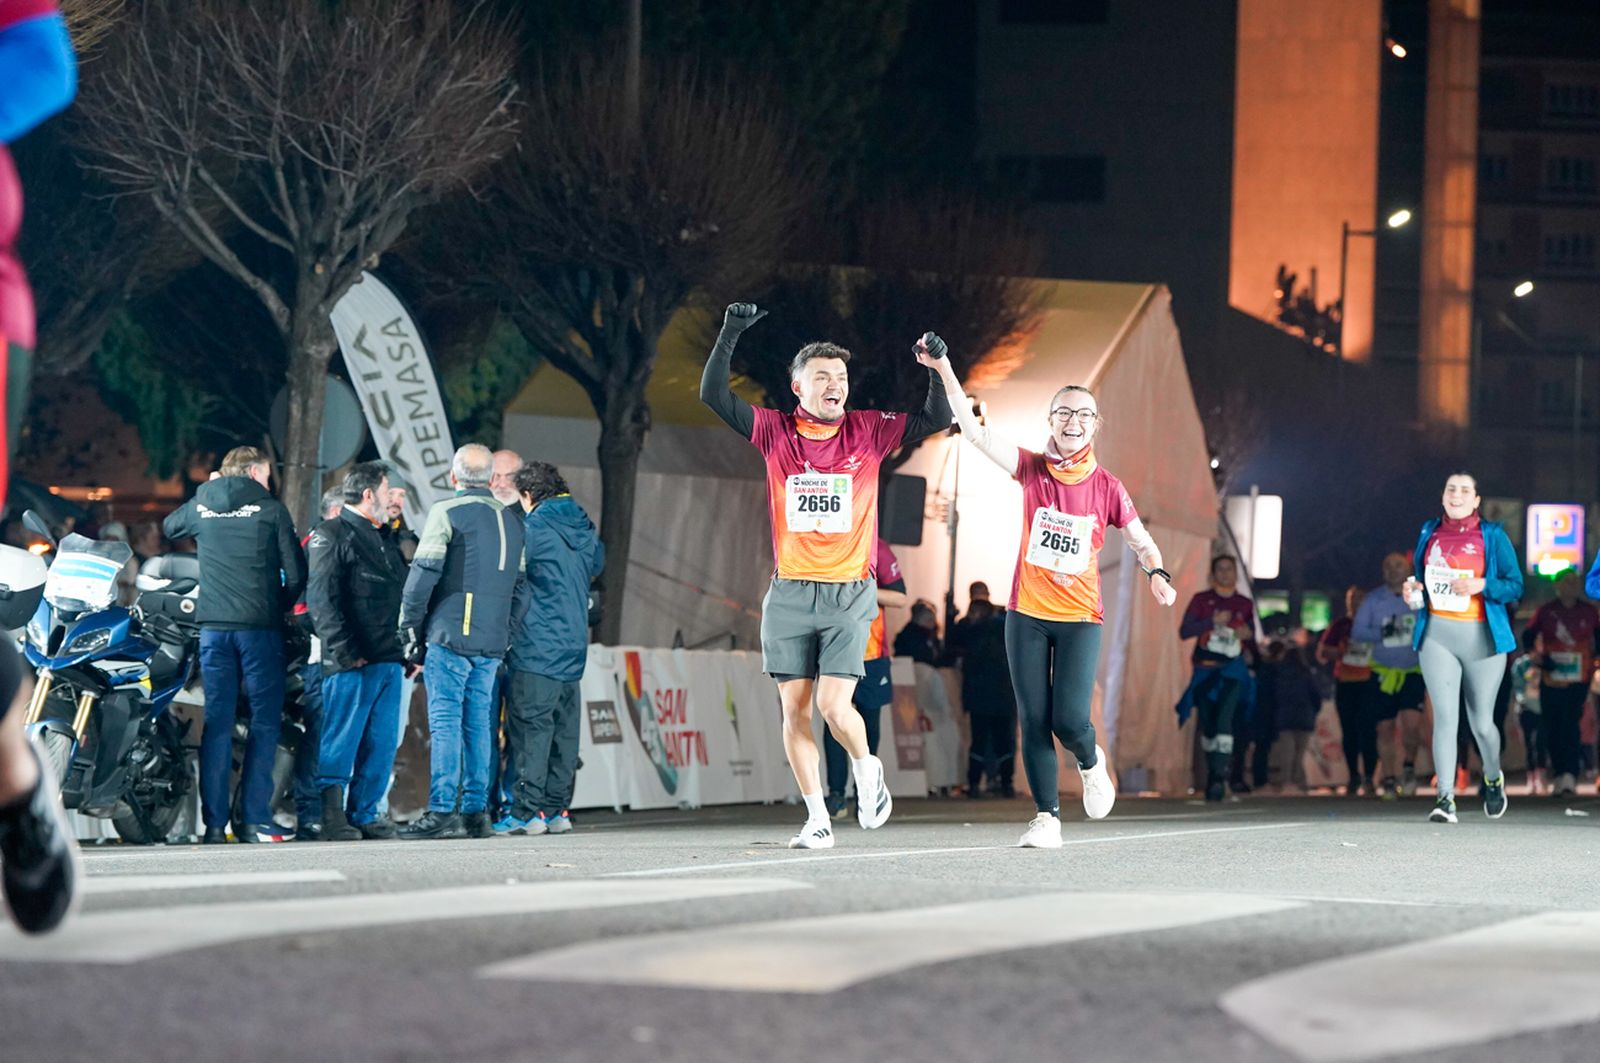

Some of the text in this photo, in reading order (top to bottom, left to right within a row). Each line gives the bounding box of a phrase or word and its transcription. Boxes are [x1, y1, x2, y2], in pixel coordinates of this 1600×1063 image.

[380, 316, 455, 492] APEMASA
[798, 494, 841, 512] 2656
[1039, 521, 1052, 530] SAN
[1040, 530, 1080, 555] 2655
[655, 688, 688, 725] SAN
